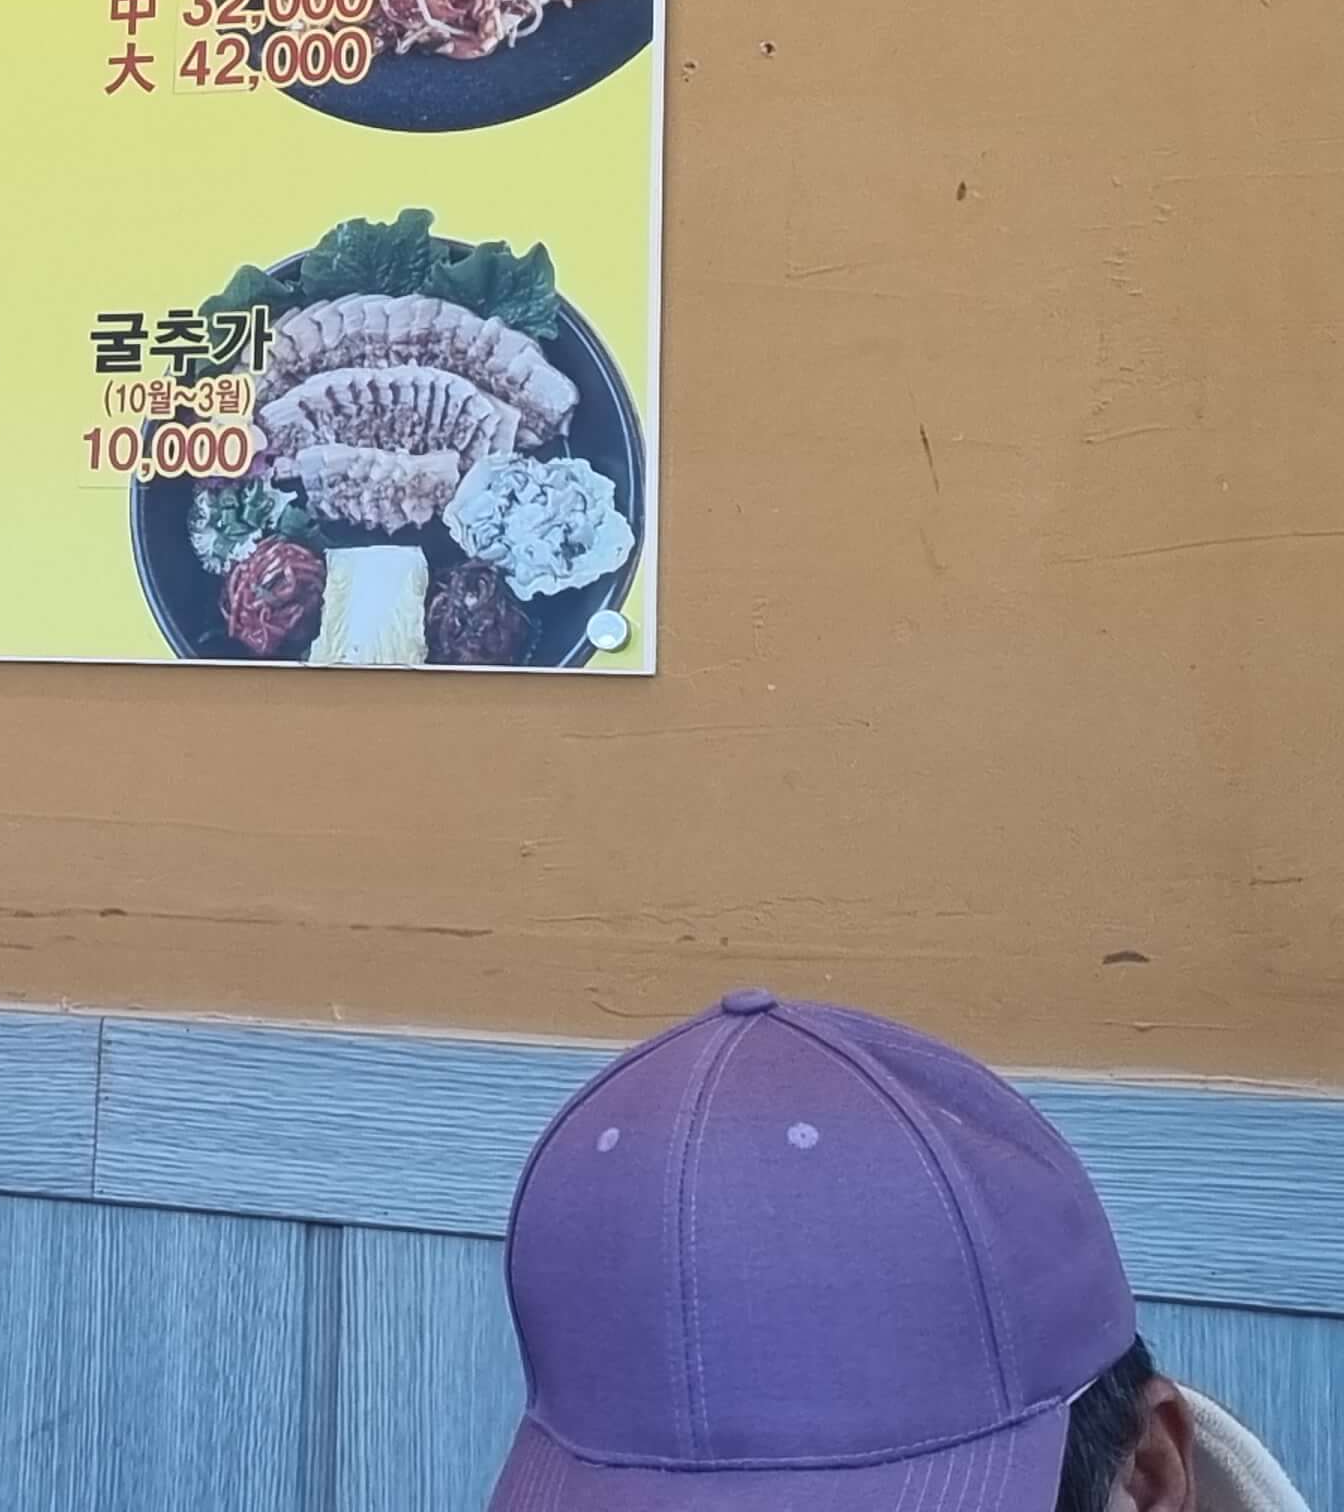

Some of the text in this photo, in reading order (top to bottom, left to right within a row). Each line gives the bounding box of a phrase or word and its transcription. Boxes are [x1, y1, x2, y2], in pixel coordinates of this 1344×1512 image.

[104, 30, 369, 95] 大 42,000
[90, 307, 274, 373] 굴추가
[104, 377, 251, 417] (10월~3월)
[83, 426, 249, 477] 10,000
